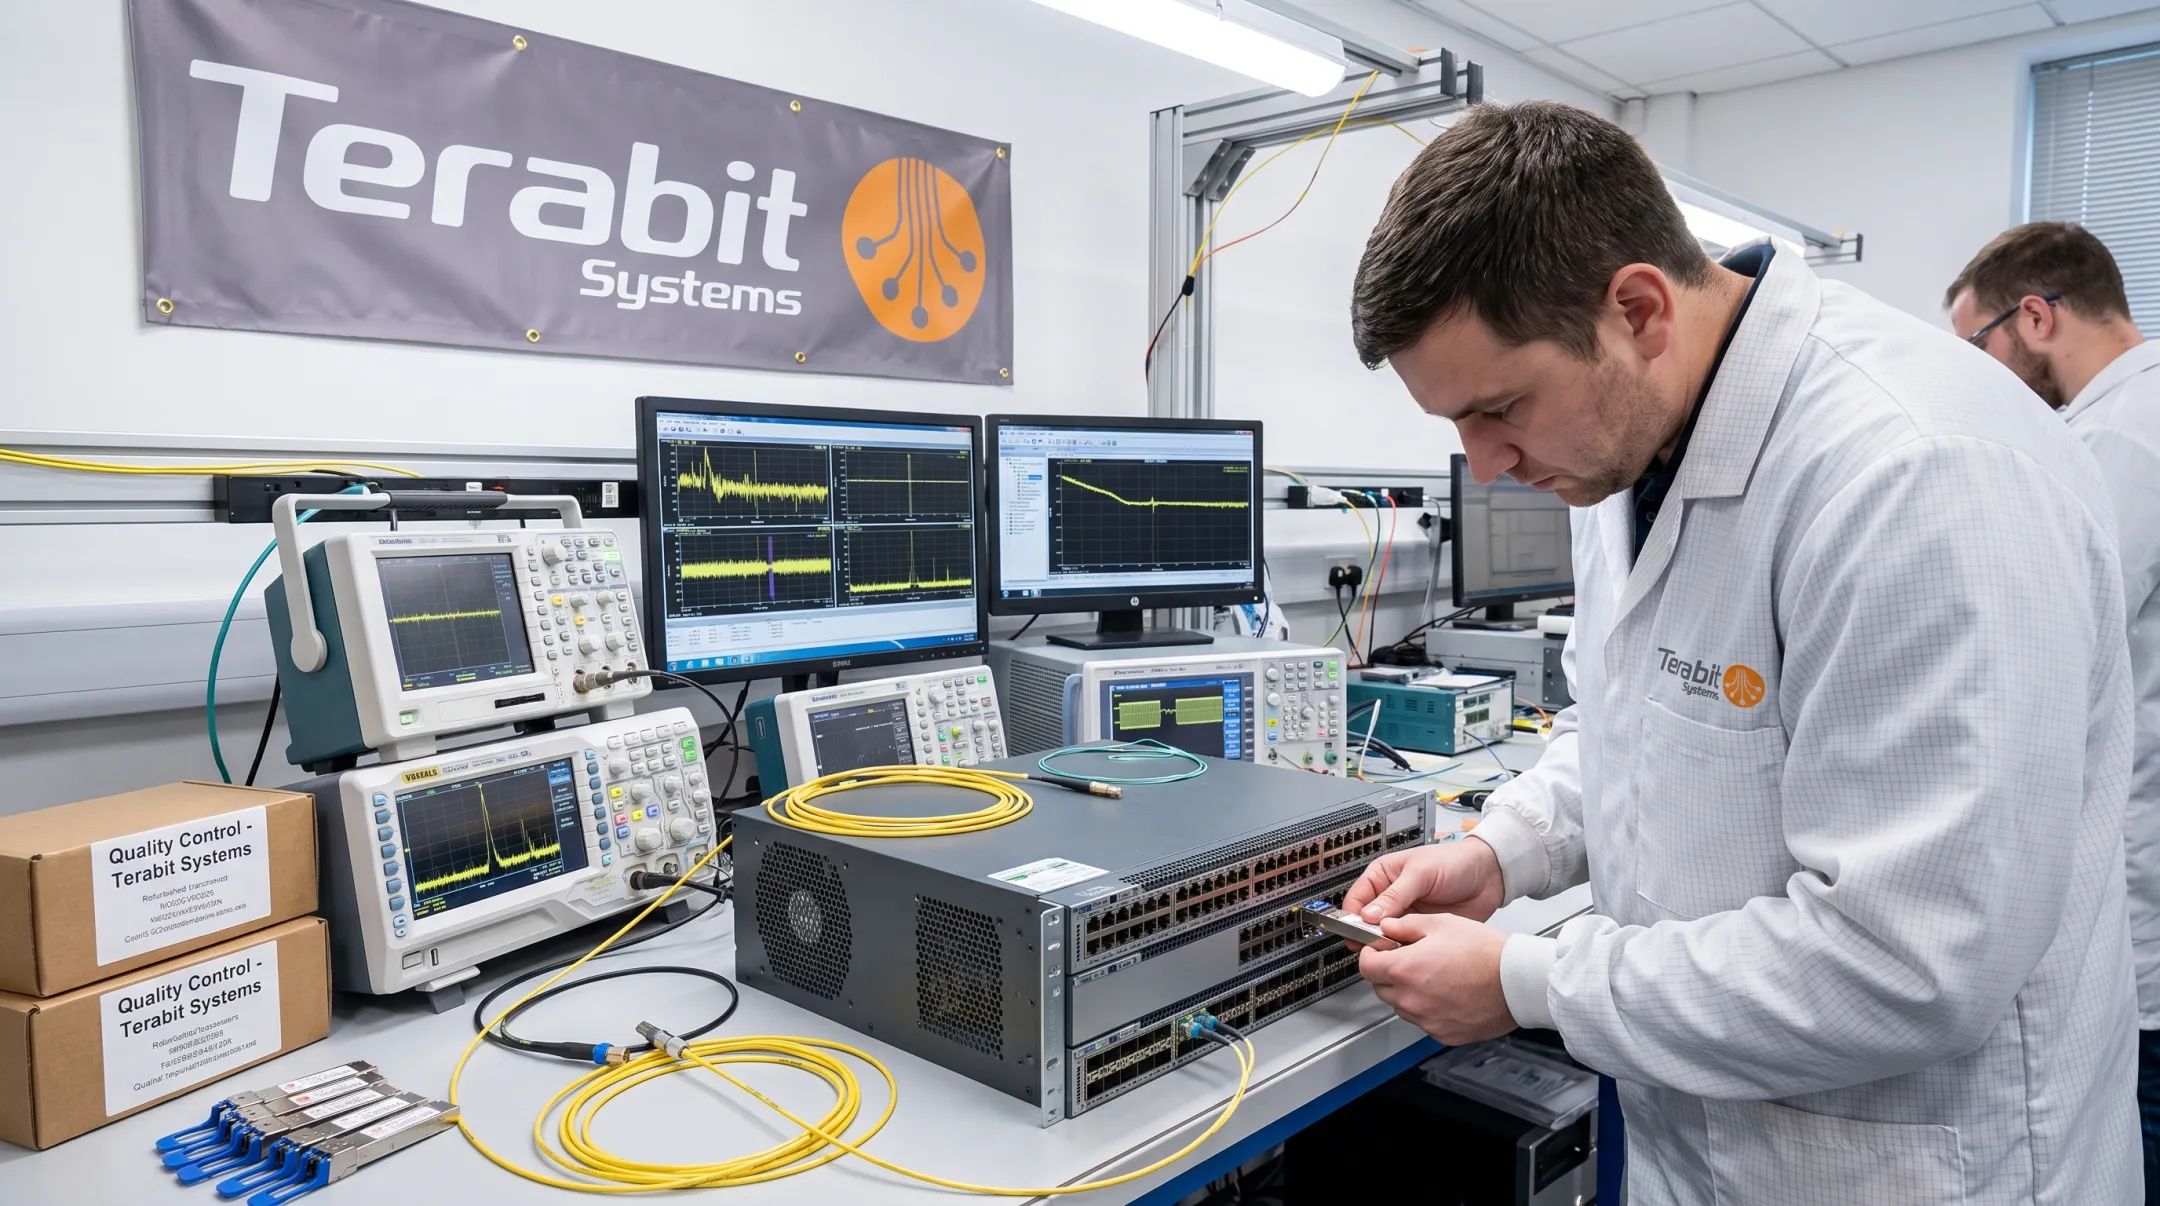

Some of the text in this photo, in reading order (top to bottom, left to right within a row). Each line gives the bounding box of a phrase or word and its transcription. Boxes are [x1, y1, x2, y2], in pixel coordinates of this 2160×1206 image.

[189, 59, 808, 272] Terabit
[579, 258, 802, 317] Systems
[1657, 647, 1722, 690] Terabit
[1682, 681, 1720, 701] Systems
[109, 839, 174, 865] Quality
[179, 820, 241, 848] Control
[111, 844, 252, 888] Terabit Systems
[118, 983, 183, 1014] Quality
[188, 958, 250, 991] Control
[119, 1004, 185, 1038] Terabit
[190, 981, 262, 1016] Systems
